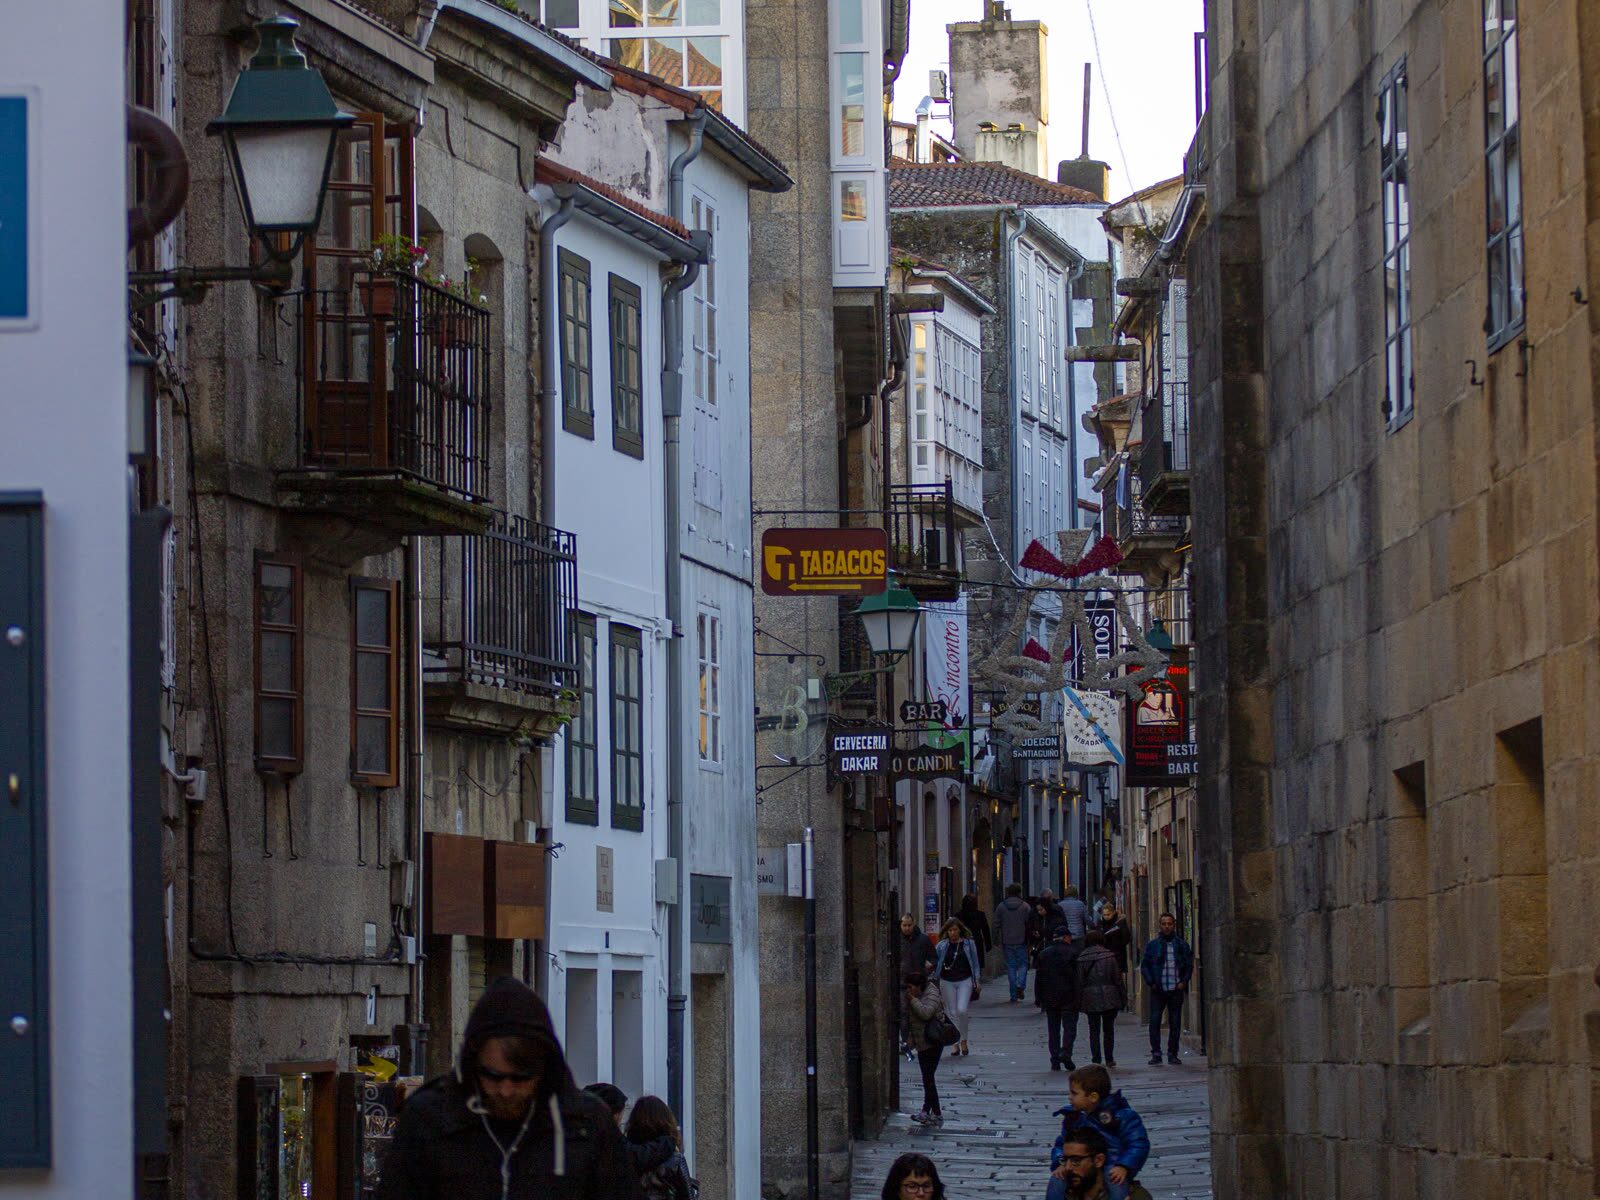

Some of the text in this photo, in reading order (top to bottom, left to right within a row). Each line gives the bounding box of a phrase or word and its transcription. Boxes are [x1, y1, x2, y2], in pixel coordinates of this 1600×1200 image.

[800, 550, 886, 577] TABACOS
[906, 703, 942, 721] BAR
[834, 736, 887, 751] CERVECERIA
[1021, 737, 1057, 747] ODEGON
[1073, 734, 1110, 747] RIBADAVIA
[841, 756, 879, 772] DAKAR
[892, 755, 957, 773] O CANDIL
[1168, 762, 1190, 775] BAR
